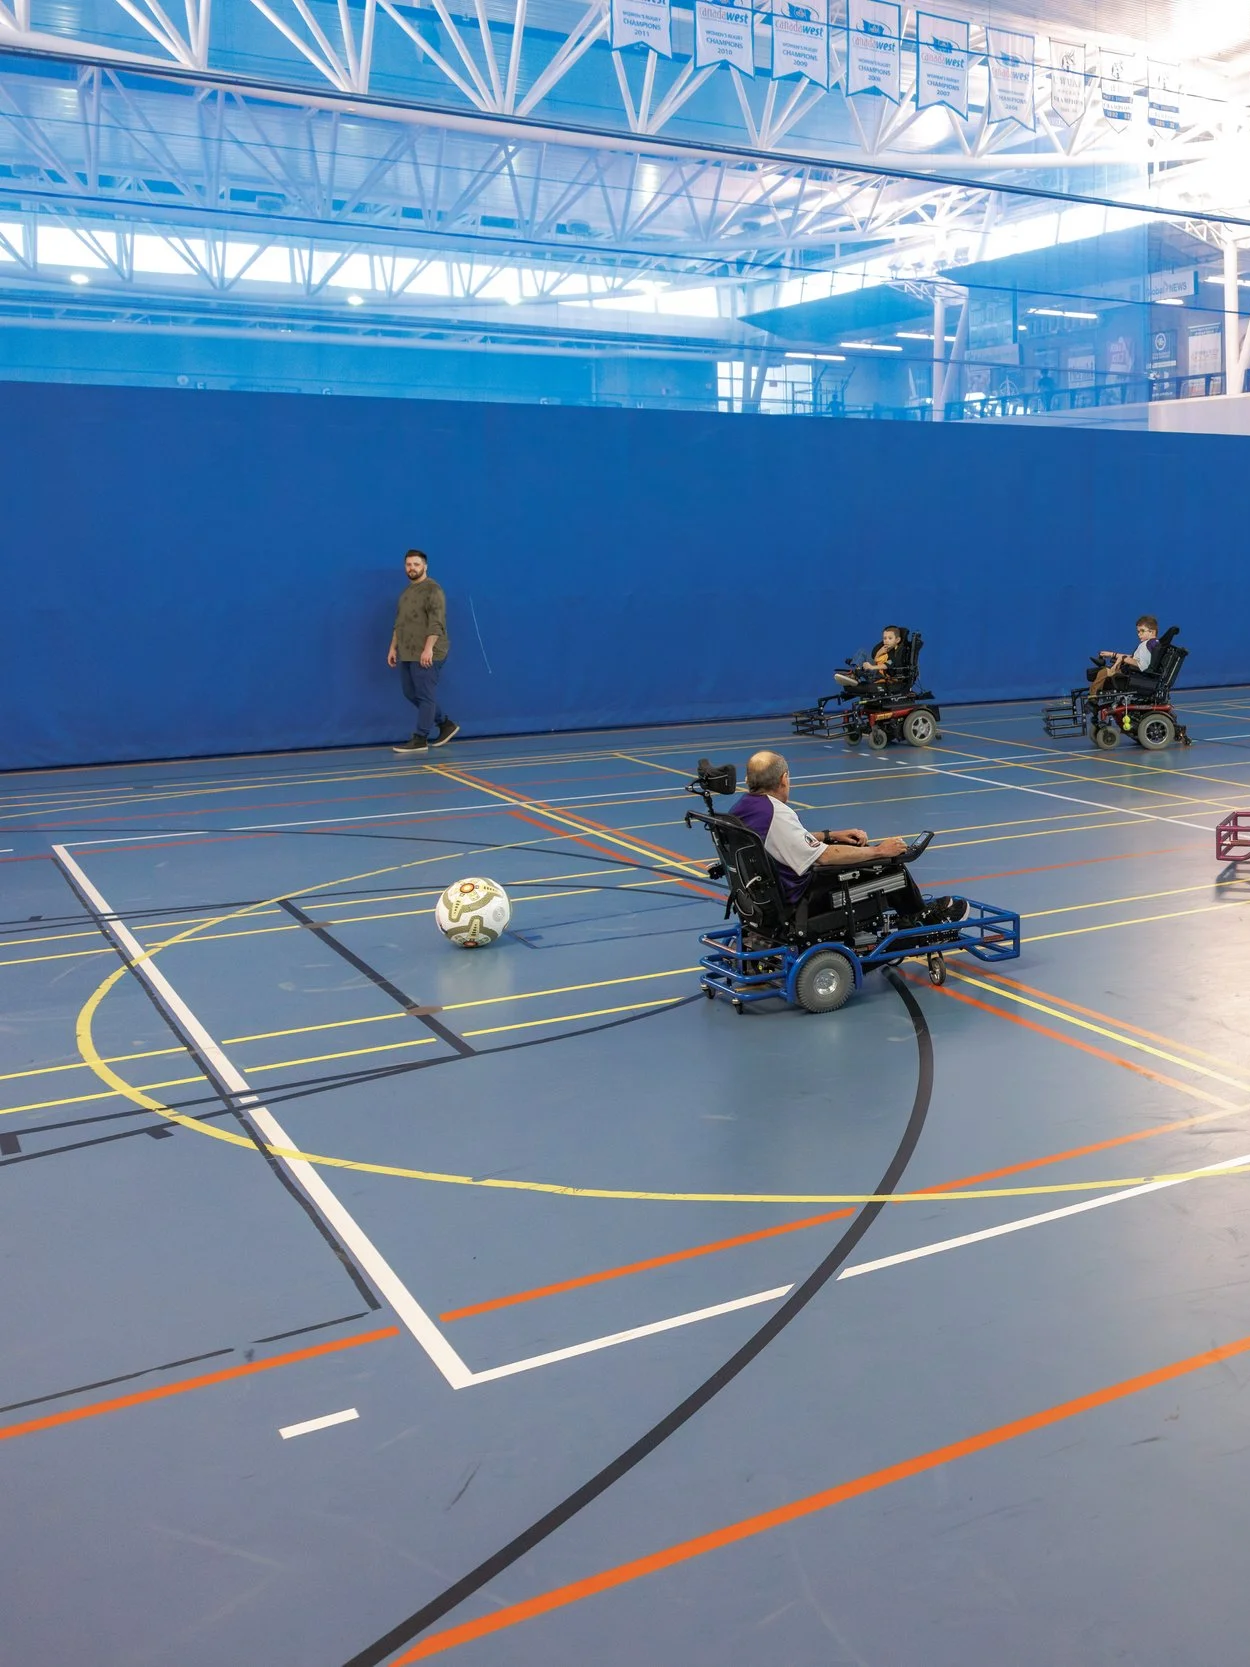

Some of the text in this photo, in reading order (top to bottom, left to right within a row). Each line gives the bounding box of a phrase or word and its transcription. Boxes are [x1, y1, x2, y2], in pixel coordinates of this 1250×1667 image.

[623, 18, 661, 30] CHAMPIONS
[706, 37, 743, 49] CHAMPIONS
[782, 50, 818, 61] CHAMPIONS
[858, 65, 891, 76] CHAMPIONS
[927, 80, 960, 91] CHAMPIONS
